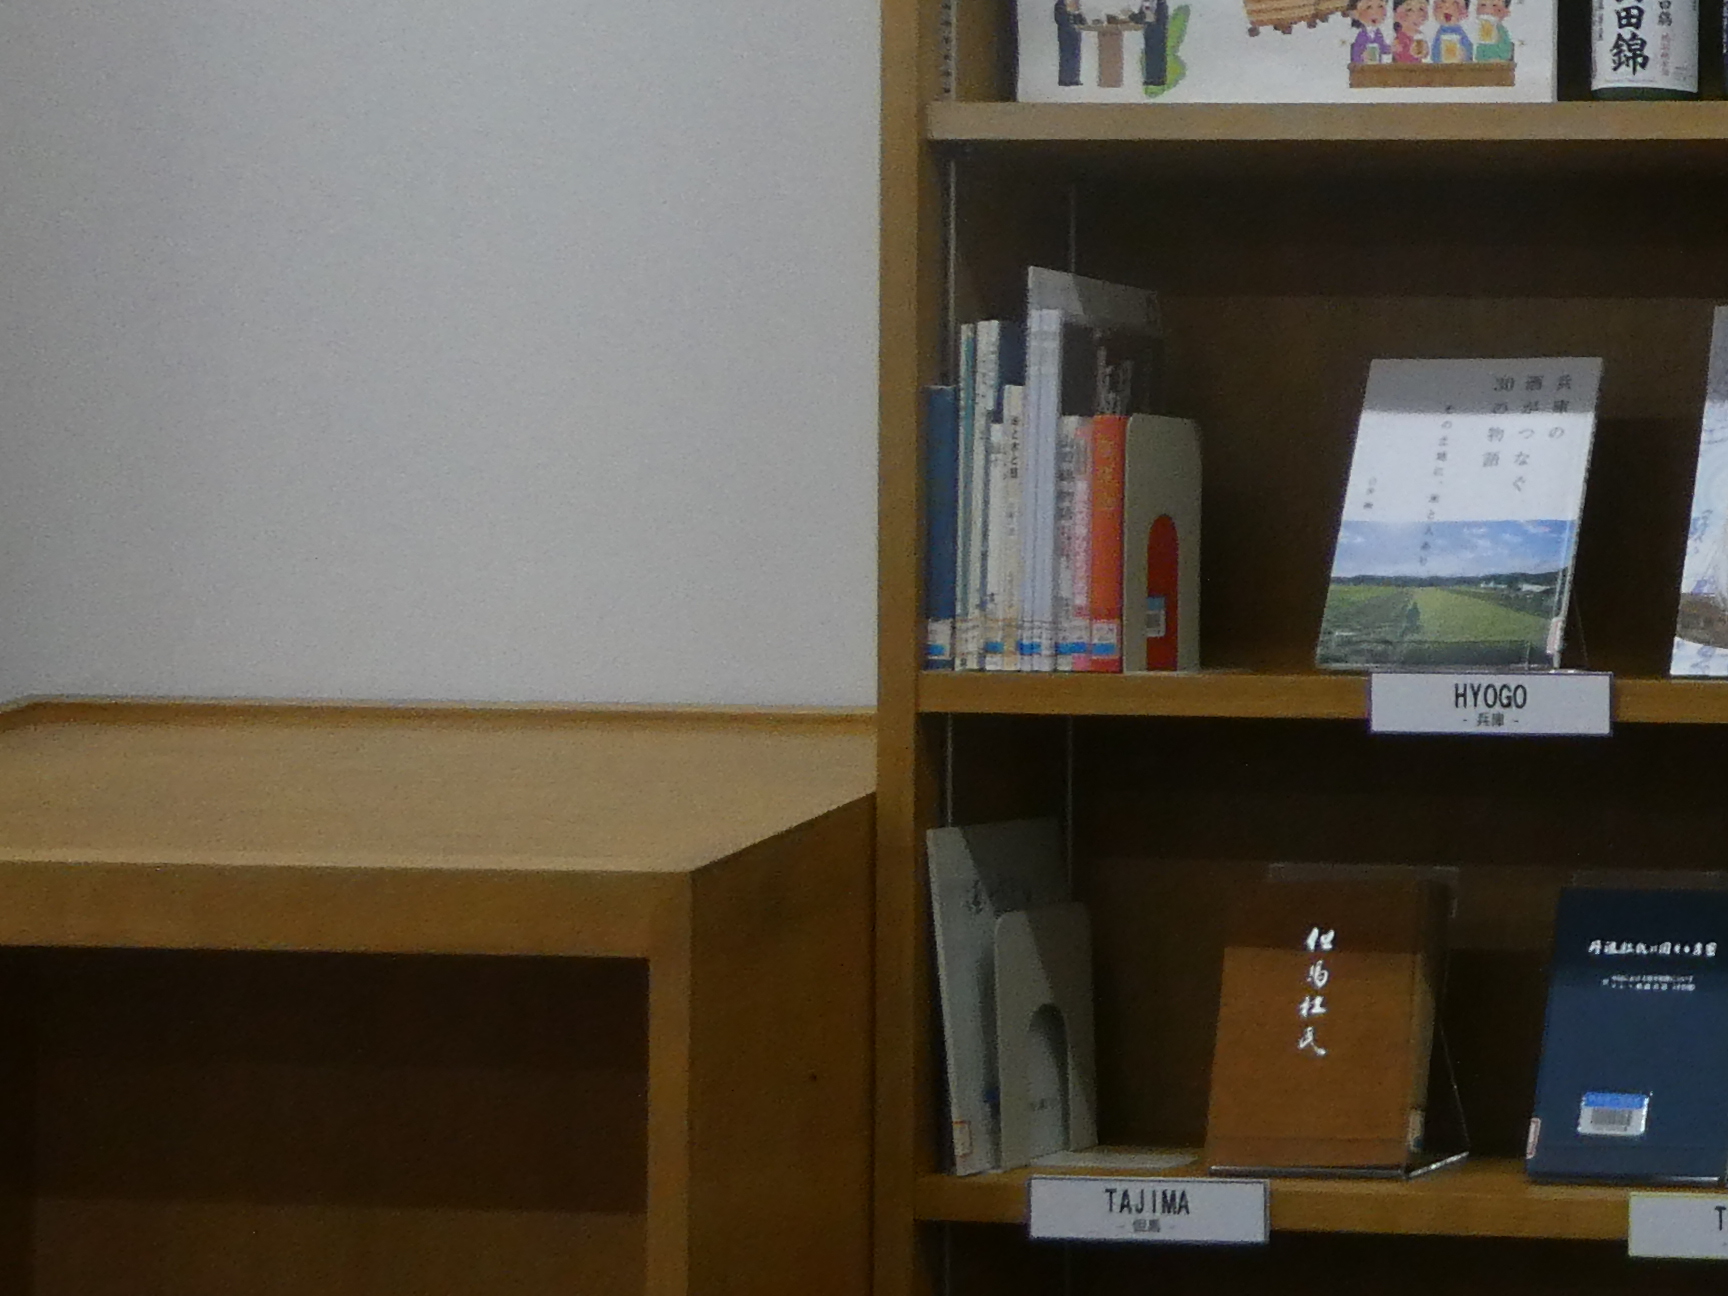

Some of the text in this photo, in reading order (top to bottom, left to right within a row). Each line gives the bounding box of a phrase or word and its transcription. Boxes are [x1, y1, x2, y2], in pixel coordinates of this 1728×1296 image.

[1454, 683, 1528, 710] HYOGO
[1475, 711, 1505, 728] 兵庫
[1104, 1188, 1191, 1216] TAJIMA
